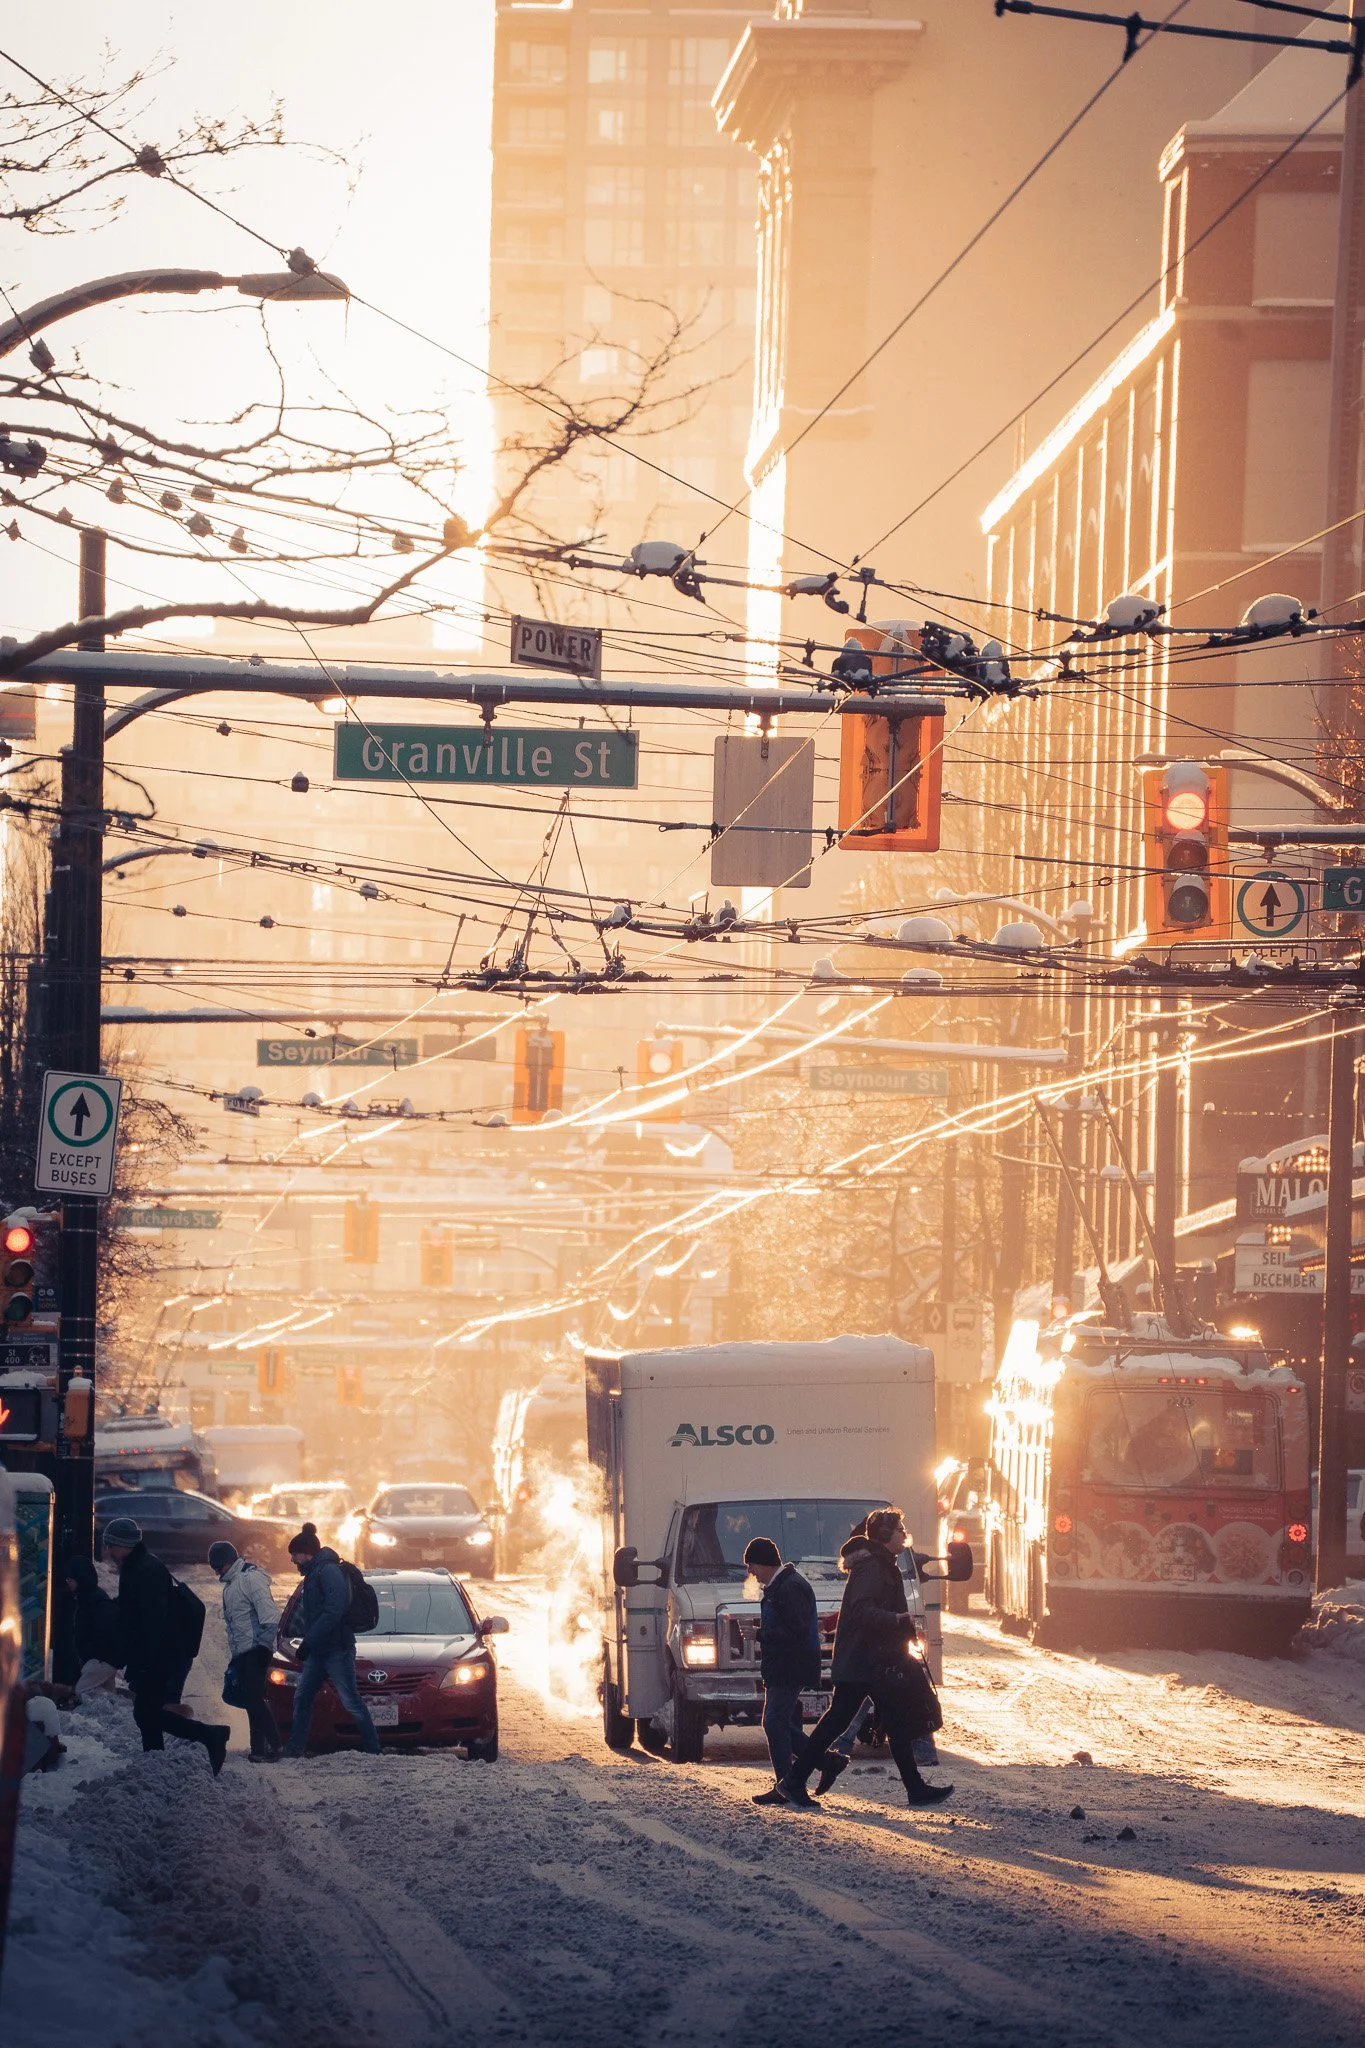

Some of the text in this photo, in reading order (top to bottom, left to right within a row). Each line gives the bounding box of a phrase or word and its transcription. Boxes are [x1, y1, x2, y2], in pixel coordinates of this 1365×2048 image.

[521, 626, 592, 661] POWER
[361, 735, 611, 778] Granville St
[268, 1041, 408, 1064] Seymour St
[818, 1068, 940, 1090] Seymour St
[49, 1152, 102, 1168] EXCEPT
[51, 1170, 97, 1185] BUSES
[1253, 1272, 1317, 1288] DECEMBER
[667, 1423, 775, 1448] ALSCO
